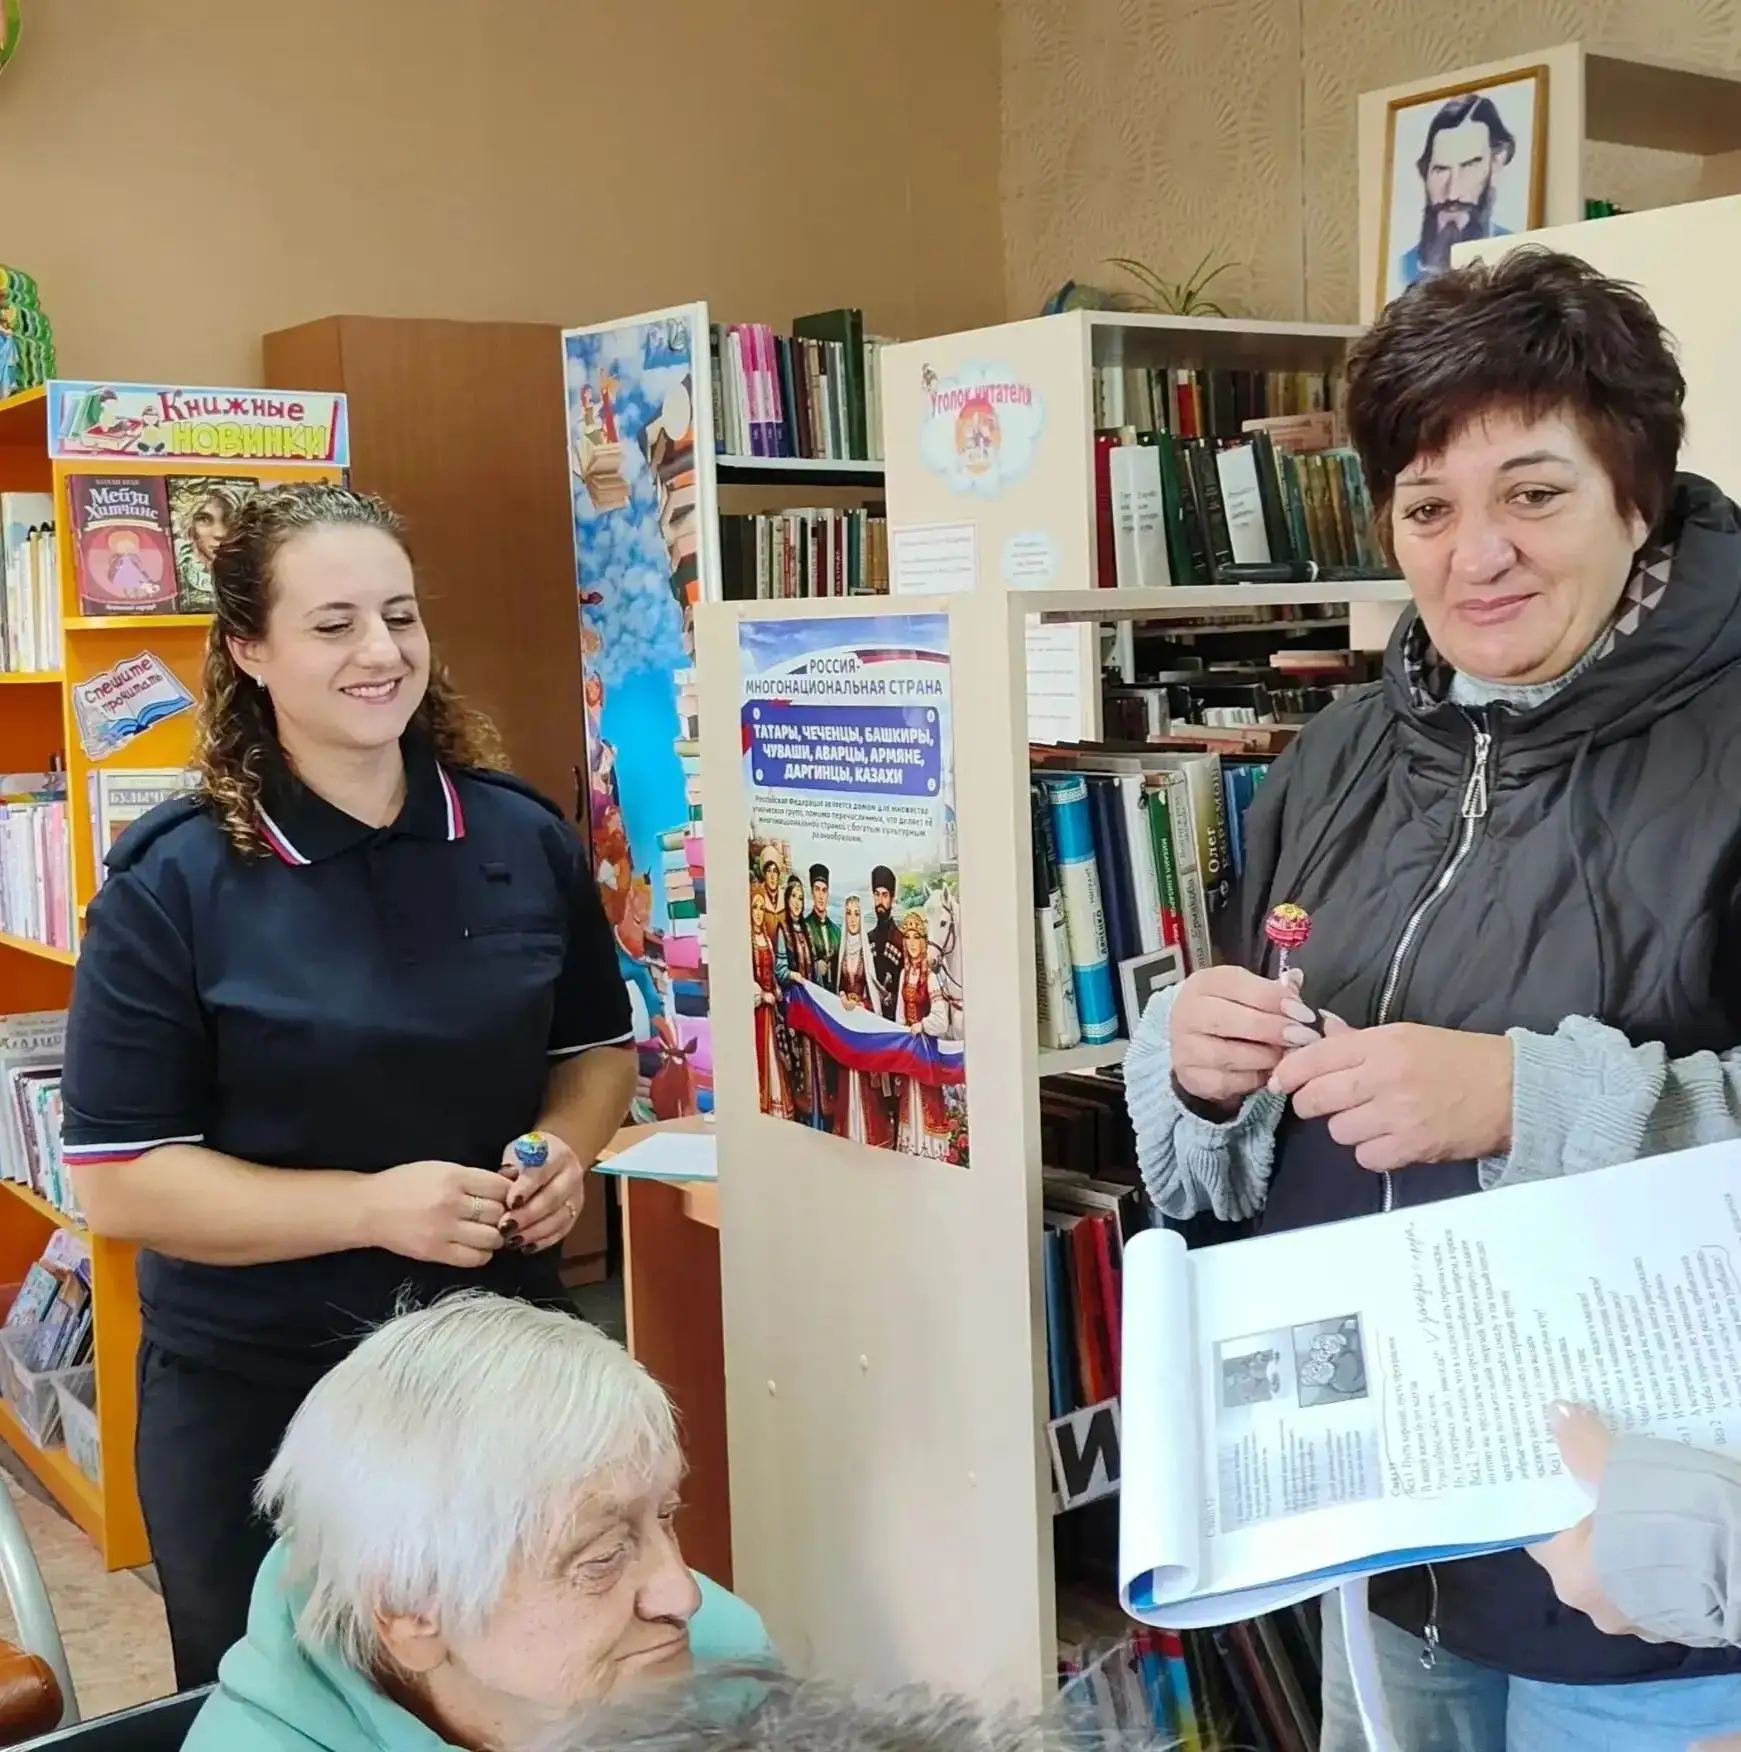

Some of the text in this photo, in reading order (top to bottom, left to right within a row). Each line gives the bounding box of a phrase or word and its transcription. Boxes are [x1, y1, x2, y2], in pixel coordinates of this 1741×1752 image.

[157, 390, 305, 422] Книжные
[172, 421, 328, 460] НОВИНКИ
[89, 488, 150, 504] Мейзи
[84, 504, 159, 520] Хитчинс
[809, 659, 861, 674] РОССИЯ-
[102, 674, 163, 714] прочитать
[745, 678, 943, 696] МНОГОНАЦИОНАЛЬНАЯ СТРАНА
[753, 724, 935, 746] ТАТАРЫ, ЧЕЧЕНЦЫ, БАШКИРЫ,
[762, 743, 924, 766] ЧУВАШИ, АВАРЦЫ, АРМЯНЕ,
[784, 763, 903, 784] ДАРГИНЦЫ, КАЗАХИ
[853, 803, 876, 812] домом
[1208, 828, 1220, 873] Олег
[1166, 874, 1177, 918] ЕЛИЗАРОВ
